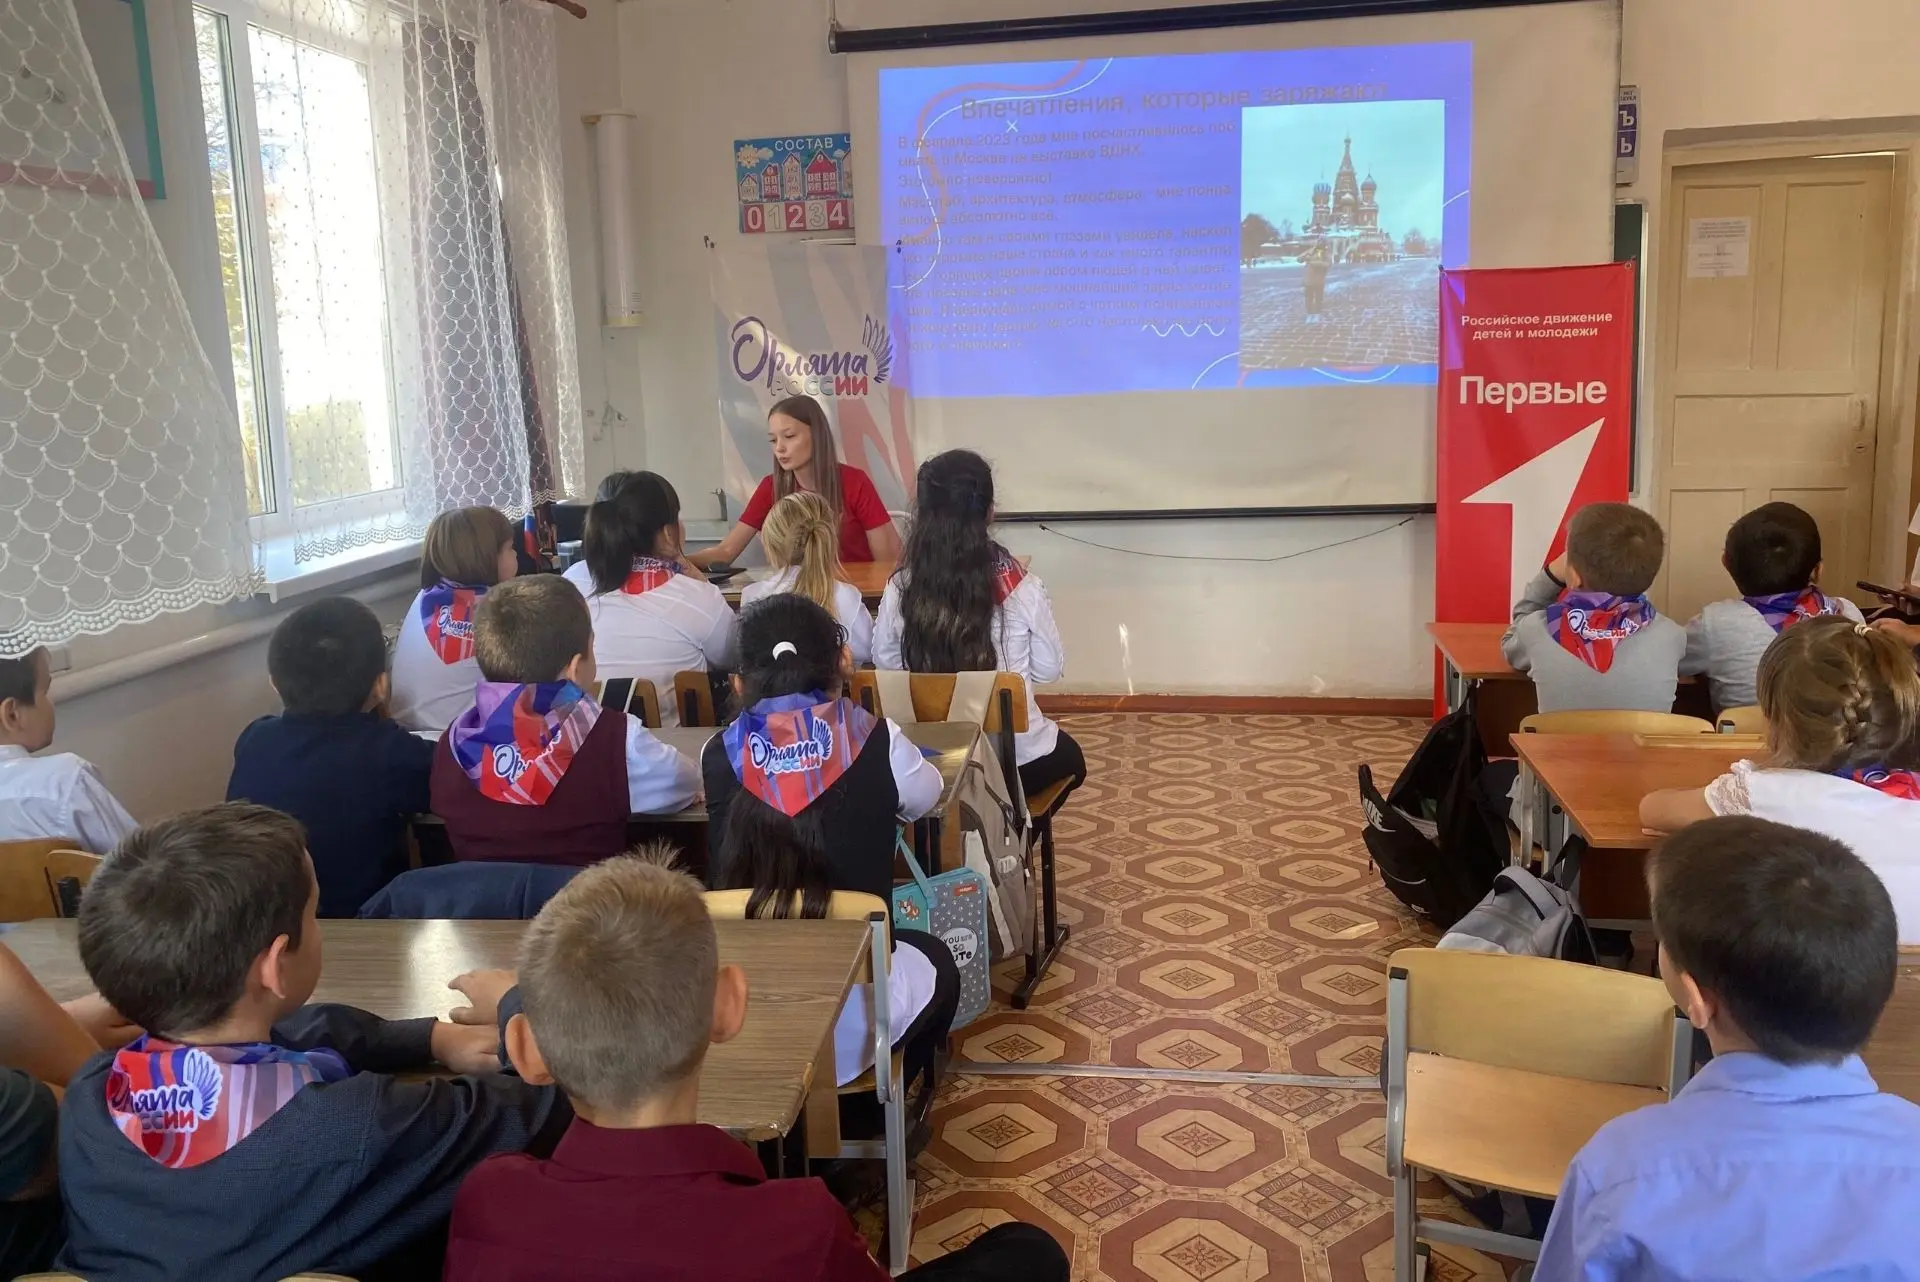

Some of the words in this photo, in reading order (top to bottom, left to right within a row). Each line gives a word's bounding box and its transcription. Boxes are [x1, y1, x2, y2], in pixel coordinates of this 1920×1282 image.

[961, 97, 1130, 120] Впечатления,
[1142, 90, 1250, 114] которые
[1260, 82, 1389, 105] заряжают
[774, 137, 834, 152] СОСТАВ
[898, 135, 906, 149] В
[976, 133, 1011, 146] 2023
[1051, 130, 1078, 141] мне
[954, 149, 1009, 164] Москве
[747, 206, 762, 230] 0
[768, 204, 782, 230] 1
[788, 204, 804, 228] 2
[808, 202, 825, 228] 3
[829, 201, 846, 225] 4
[1461, 314, 1540, 326] Российское
[1543, 312, 1613, 325] движение
[1472, 328, 1512, 341] детей
[1515, 330, 1524, 338] и
[1527, 326, 1598, 339] молодежи
[731, 316, 868, 389] Орлята
[1459, 375, 1608, 414] Первые
[749, 733, 819, 769] Орлята
[943, 935, 960, 944] YOU
